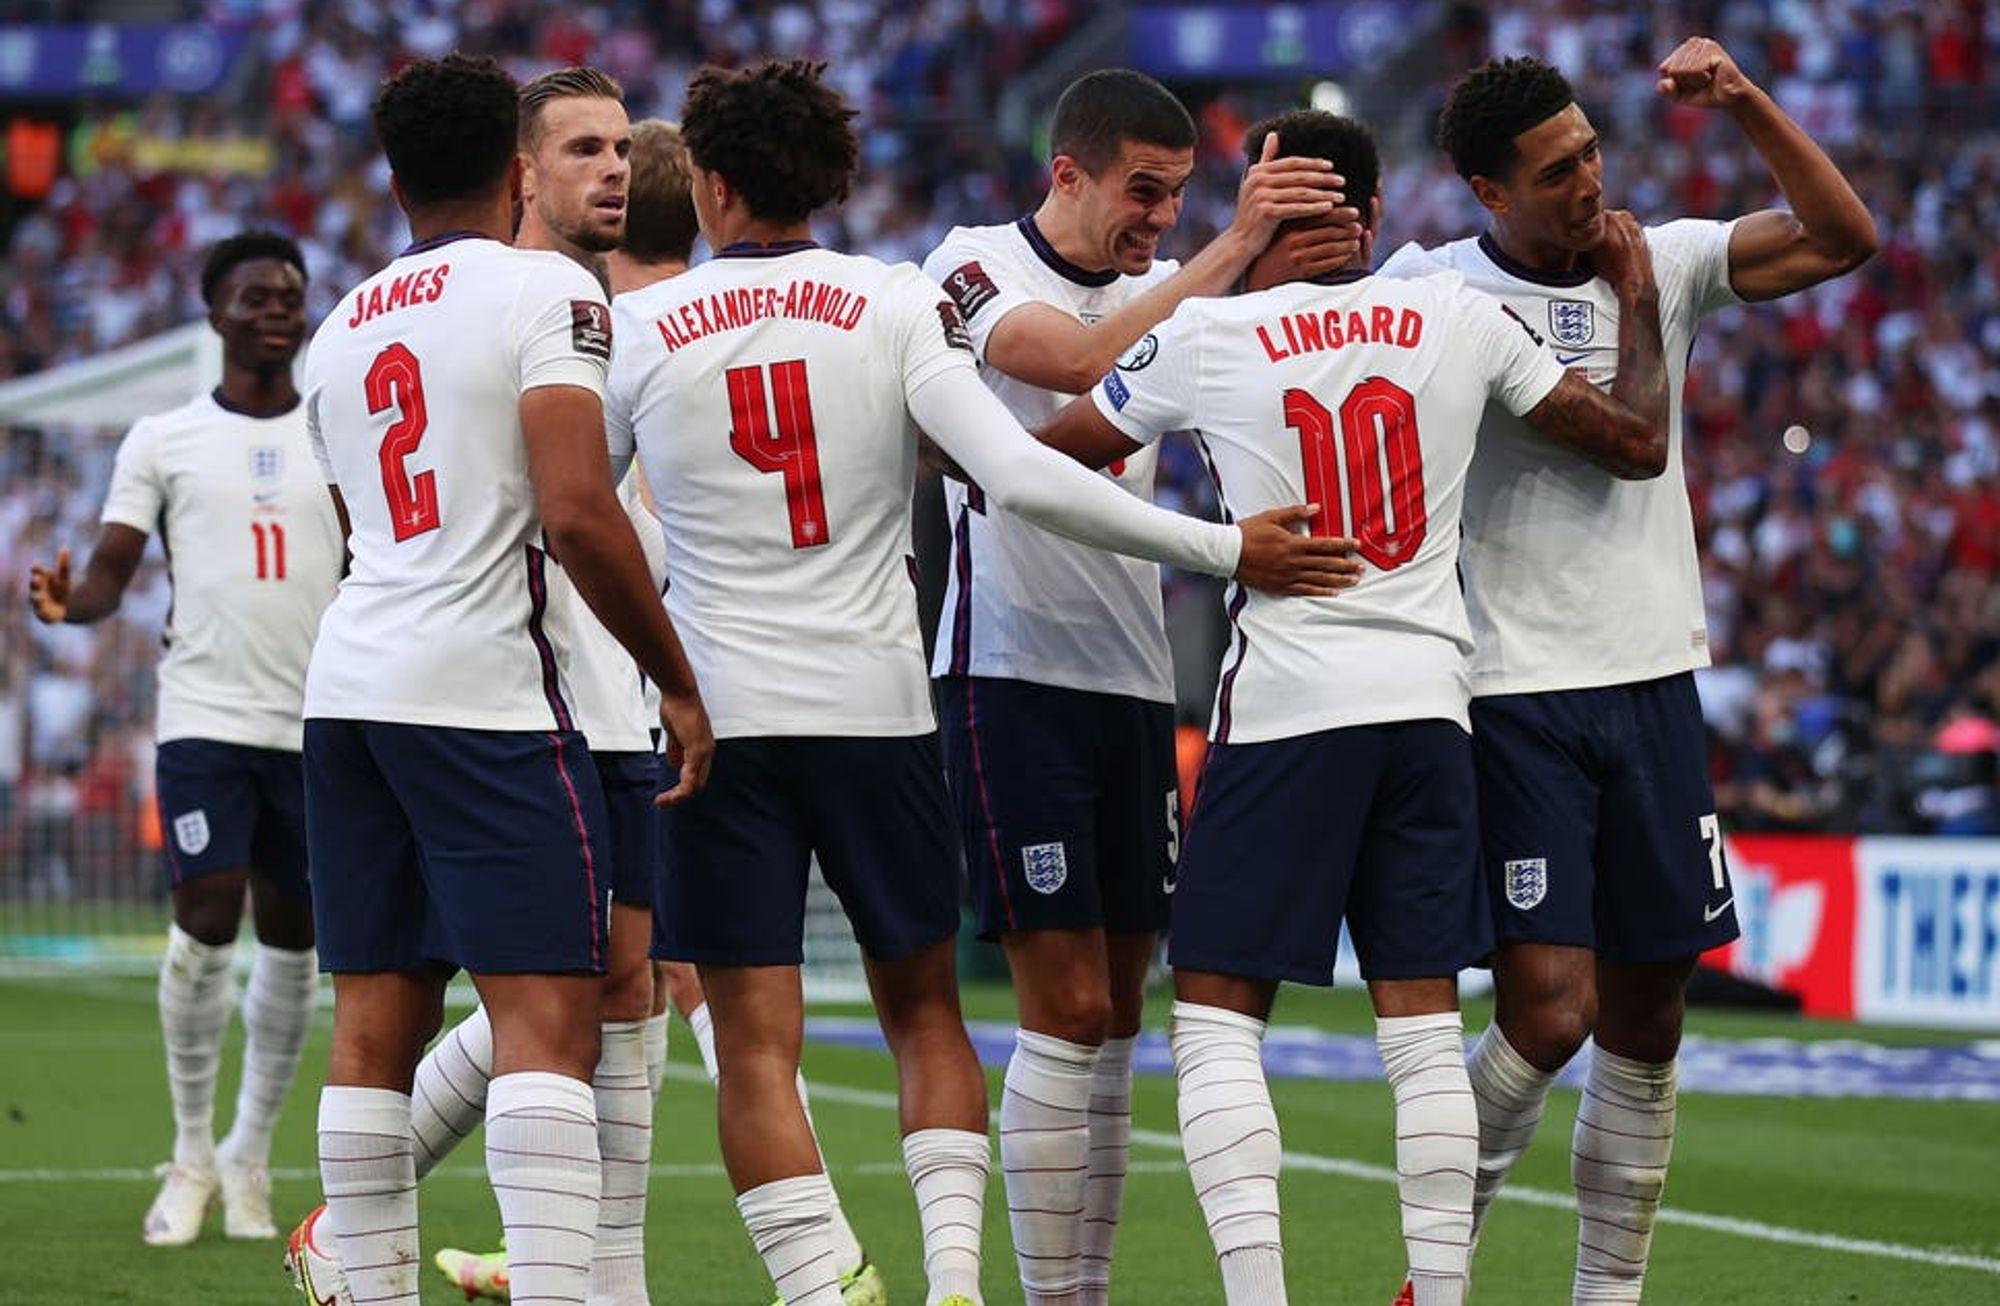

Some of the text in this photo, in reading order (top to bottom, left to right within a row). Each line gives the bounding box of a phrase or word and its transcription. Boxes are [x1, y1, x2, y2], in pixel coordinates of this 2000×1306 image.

[349, 264, 450, 329] JAMES
[656, 280, 868, 353] ALEXANDER-ARNOLD
[1255, 305, 1423, 363] LINGARD
[364, 341, 441, 544] 2
[725, 358, 830, 550] 4
[1282, 375, 1428, 571] 10
[251, 521, 287, 581] 11
[1698, 812, 1725, 890] 7
